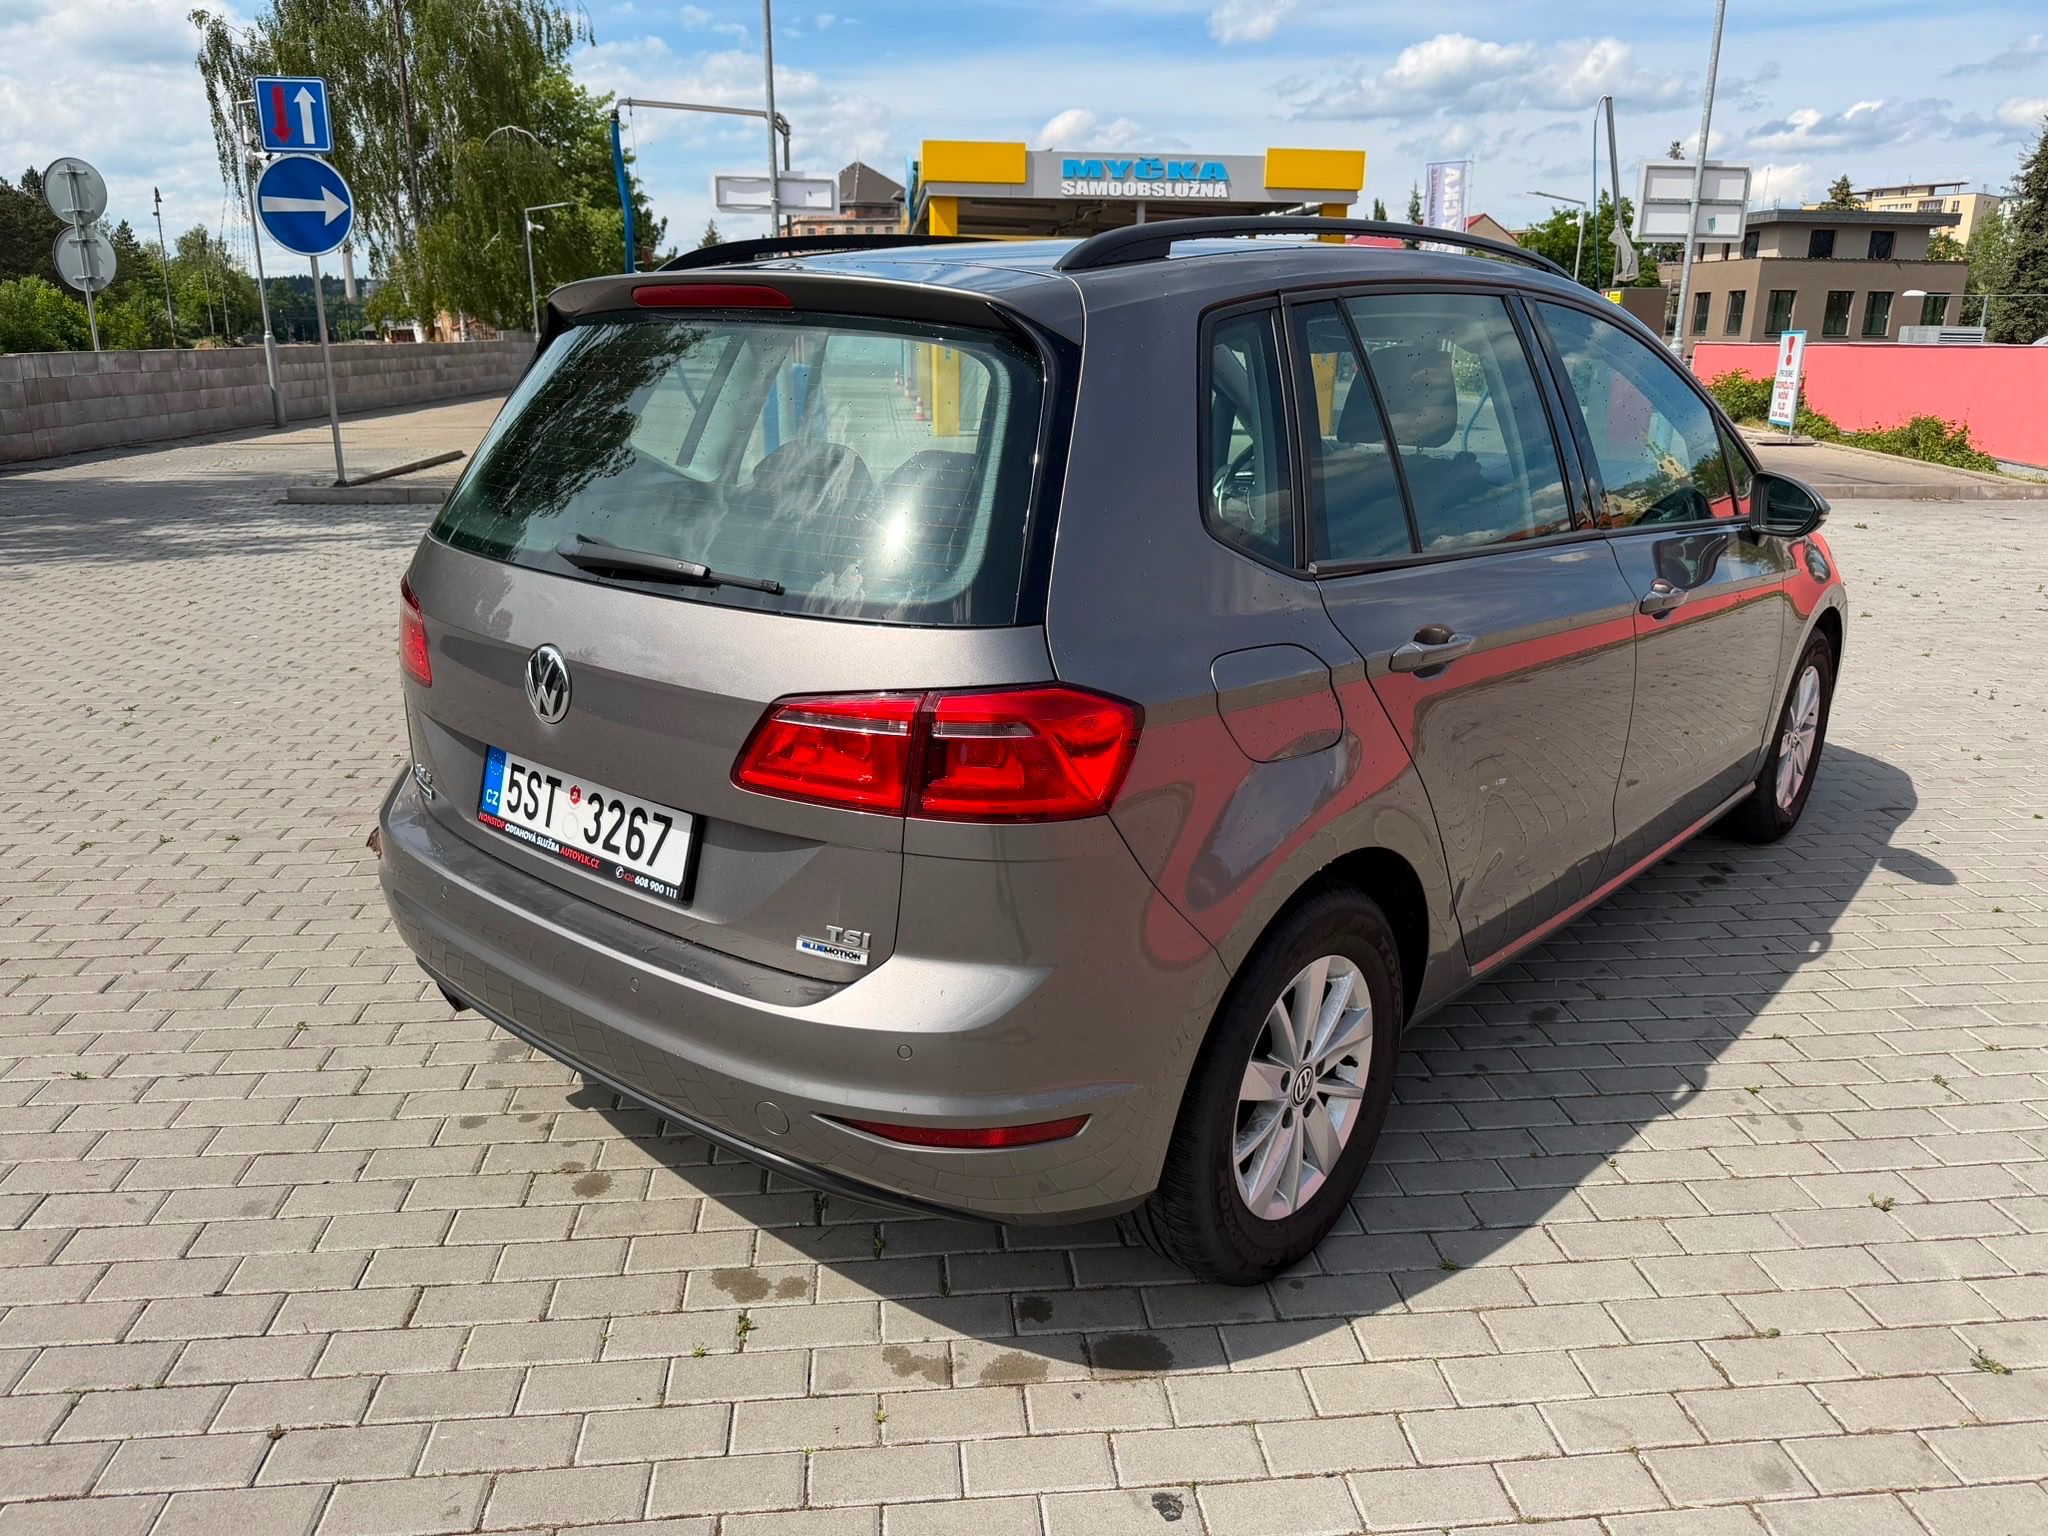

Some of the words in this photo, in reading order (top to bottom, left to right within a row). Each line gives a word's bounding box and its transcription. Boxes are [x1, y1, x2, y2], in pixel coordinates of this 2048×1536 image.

[1061, 156, 1229, 181] MYČKA
[1060, 180, 1228, 198] SAMOOBSLUŽNÁ
[486, 789, 499, 806] CZ
[506, 762, 562, 828] 5ST
[583, 792, 673, 867] 3267
[478, 811, 505, 829] NONSTOP
[504, 823, 537, 843] ODTAHOVÁ
[536, 836, 560, 853] SLUŽBA
[560, 846, 600, 869] AUTOVLK.CZ
[634, 875, 649, 888] 608
[649, 880, 665, 894] 900
[665, 886, 678, 899] 111
[826, 925, 871, 949] TSI
[802, 941, 861, 960] BLUEMOTION
